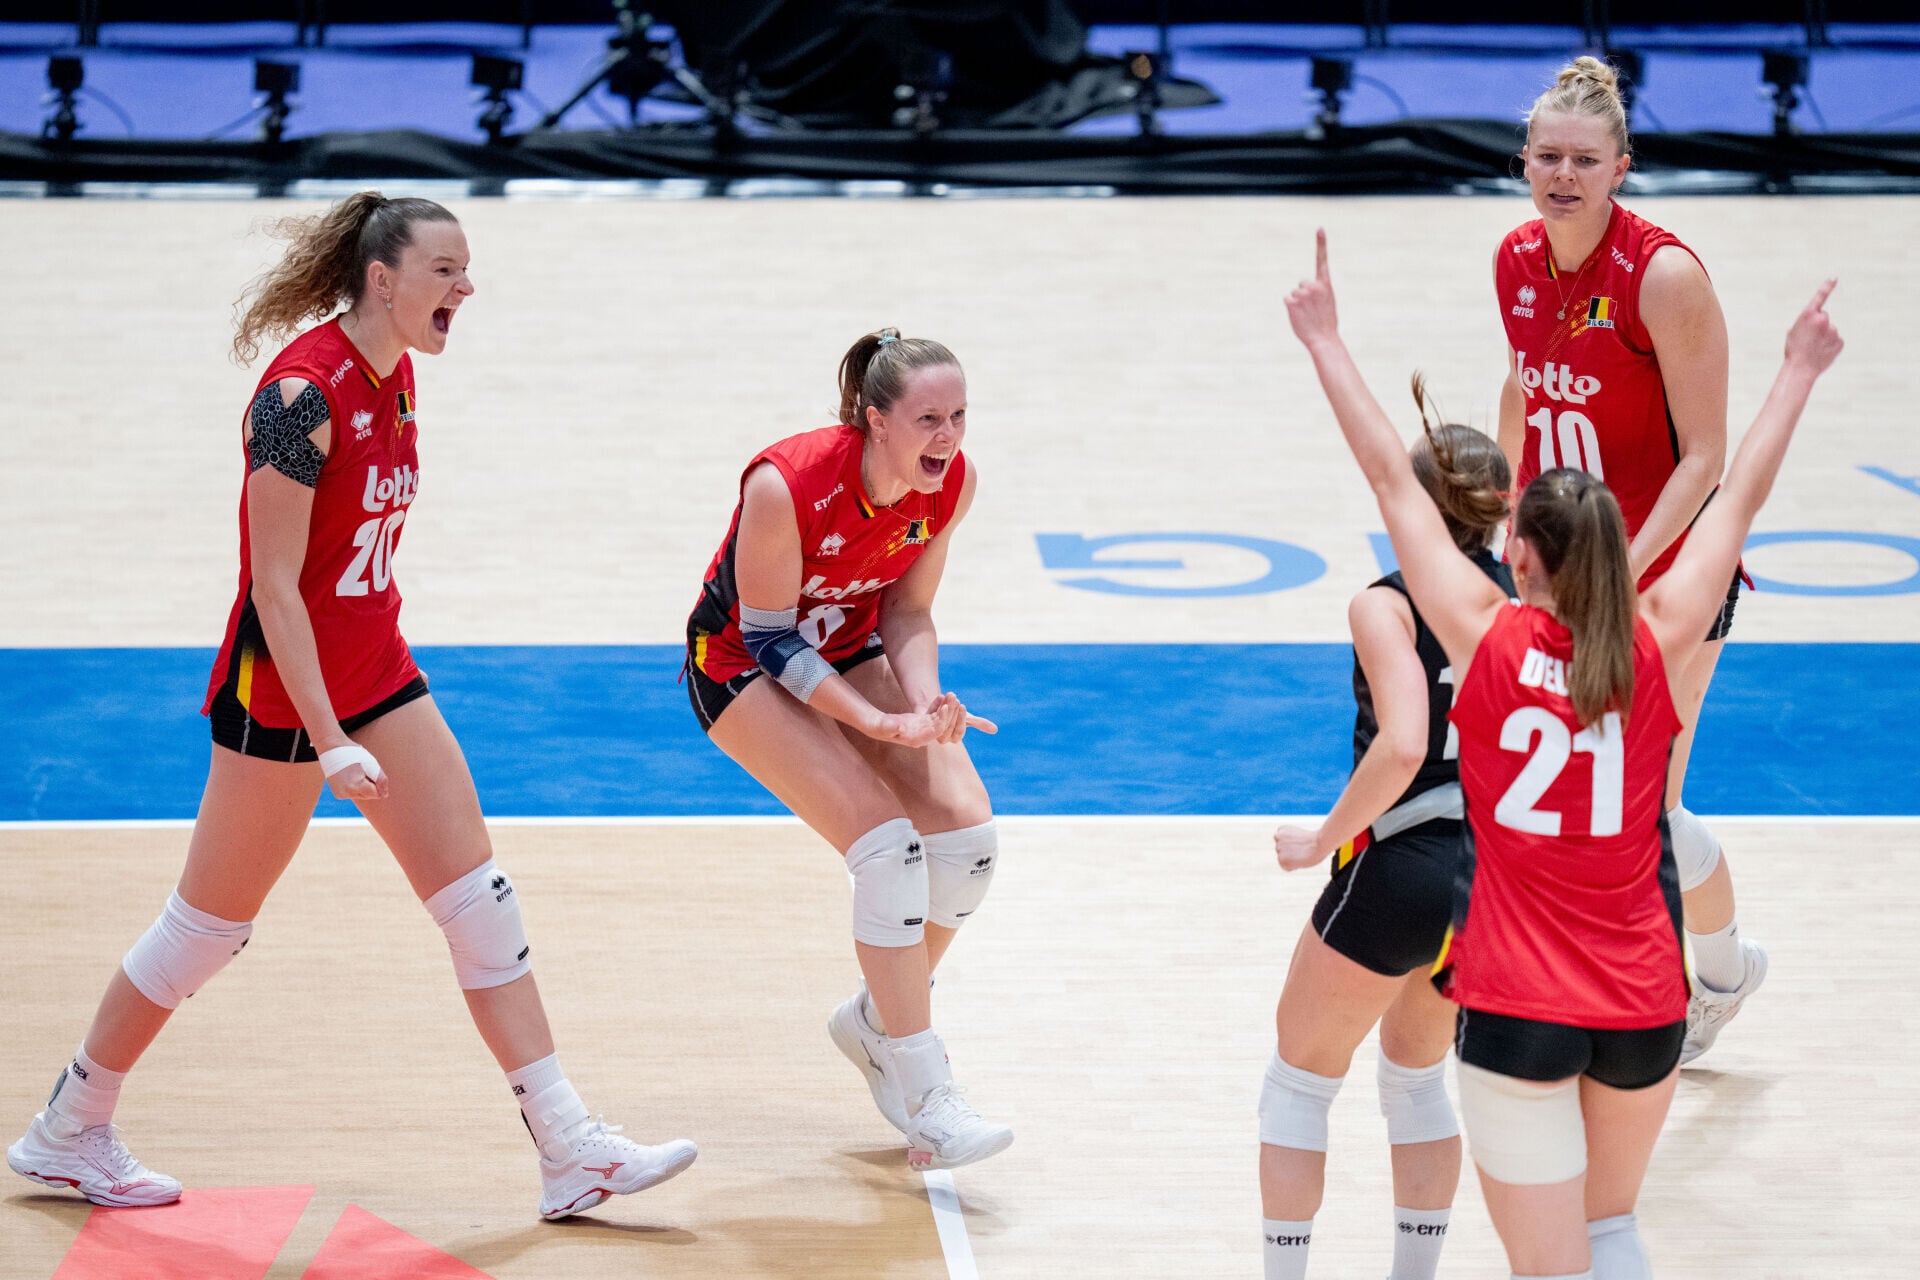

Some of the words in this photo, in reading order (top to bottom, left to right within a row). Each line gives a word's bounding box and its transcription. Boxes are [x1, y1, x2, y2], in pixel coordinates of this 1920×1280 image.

[1527, 406, 1605, 482] 10
[335, 509, 406, 597] 20
[1494, 706, 1625, 837] 21
